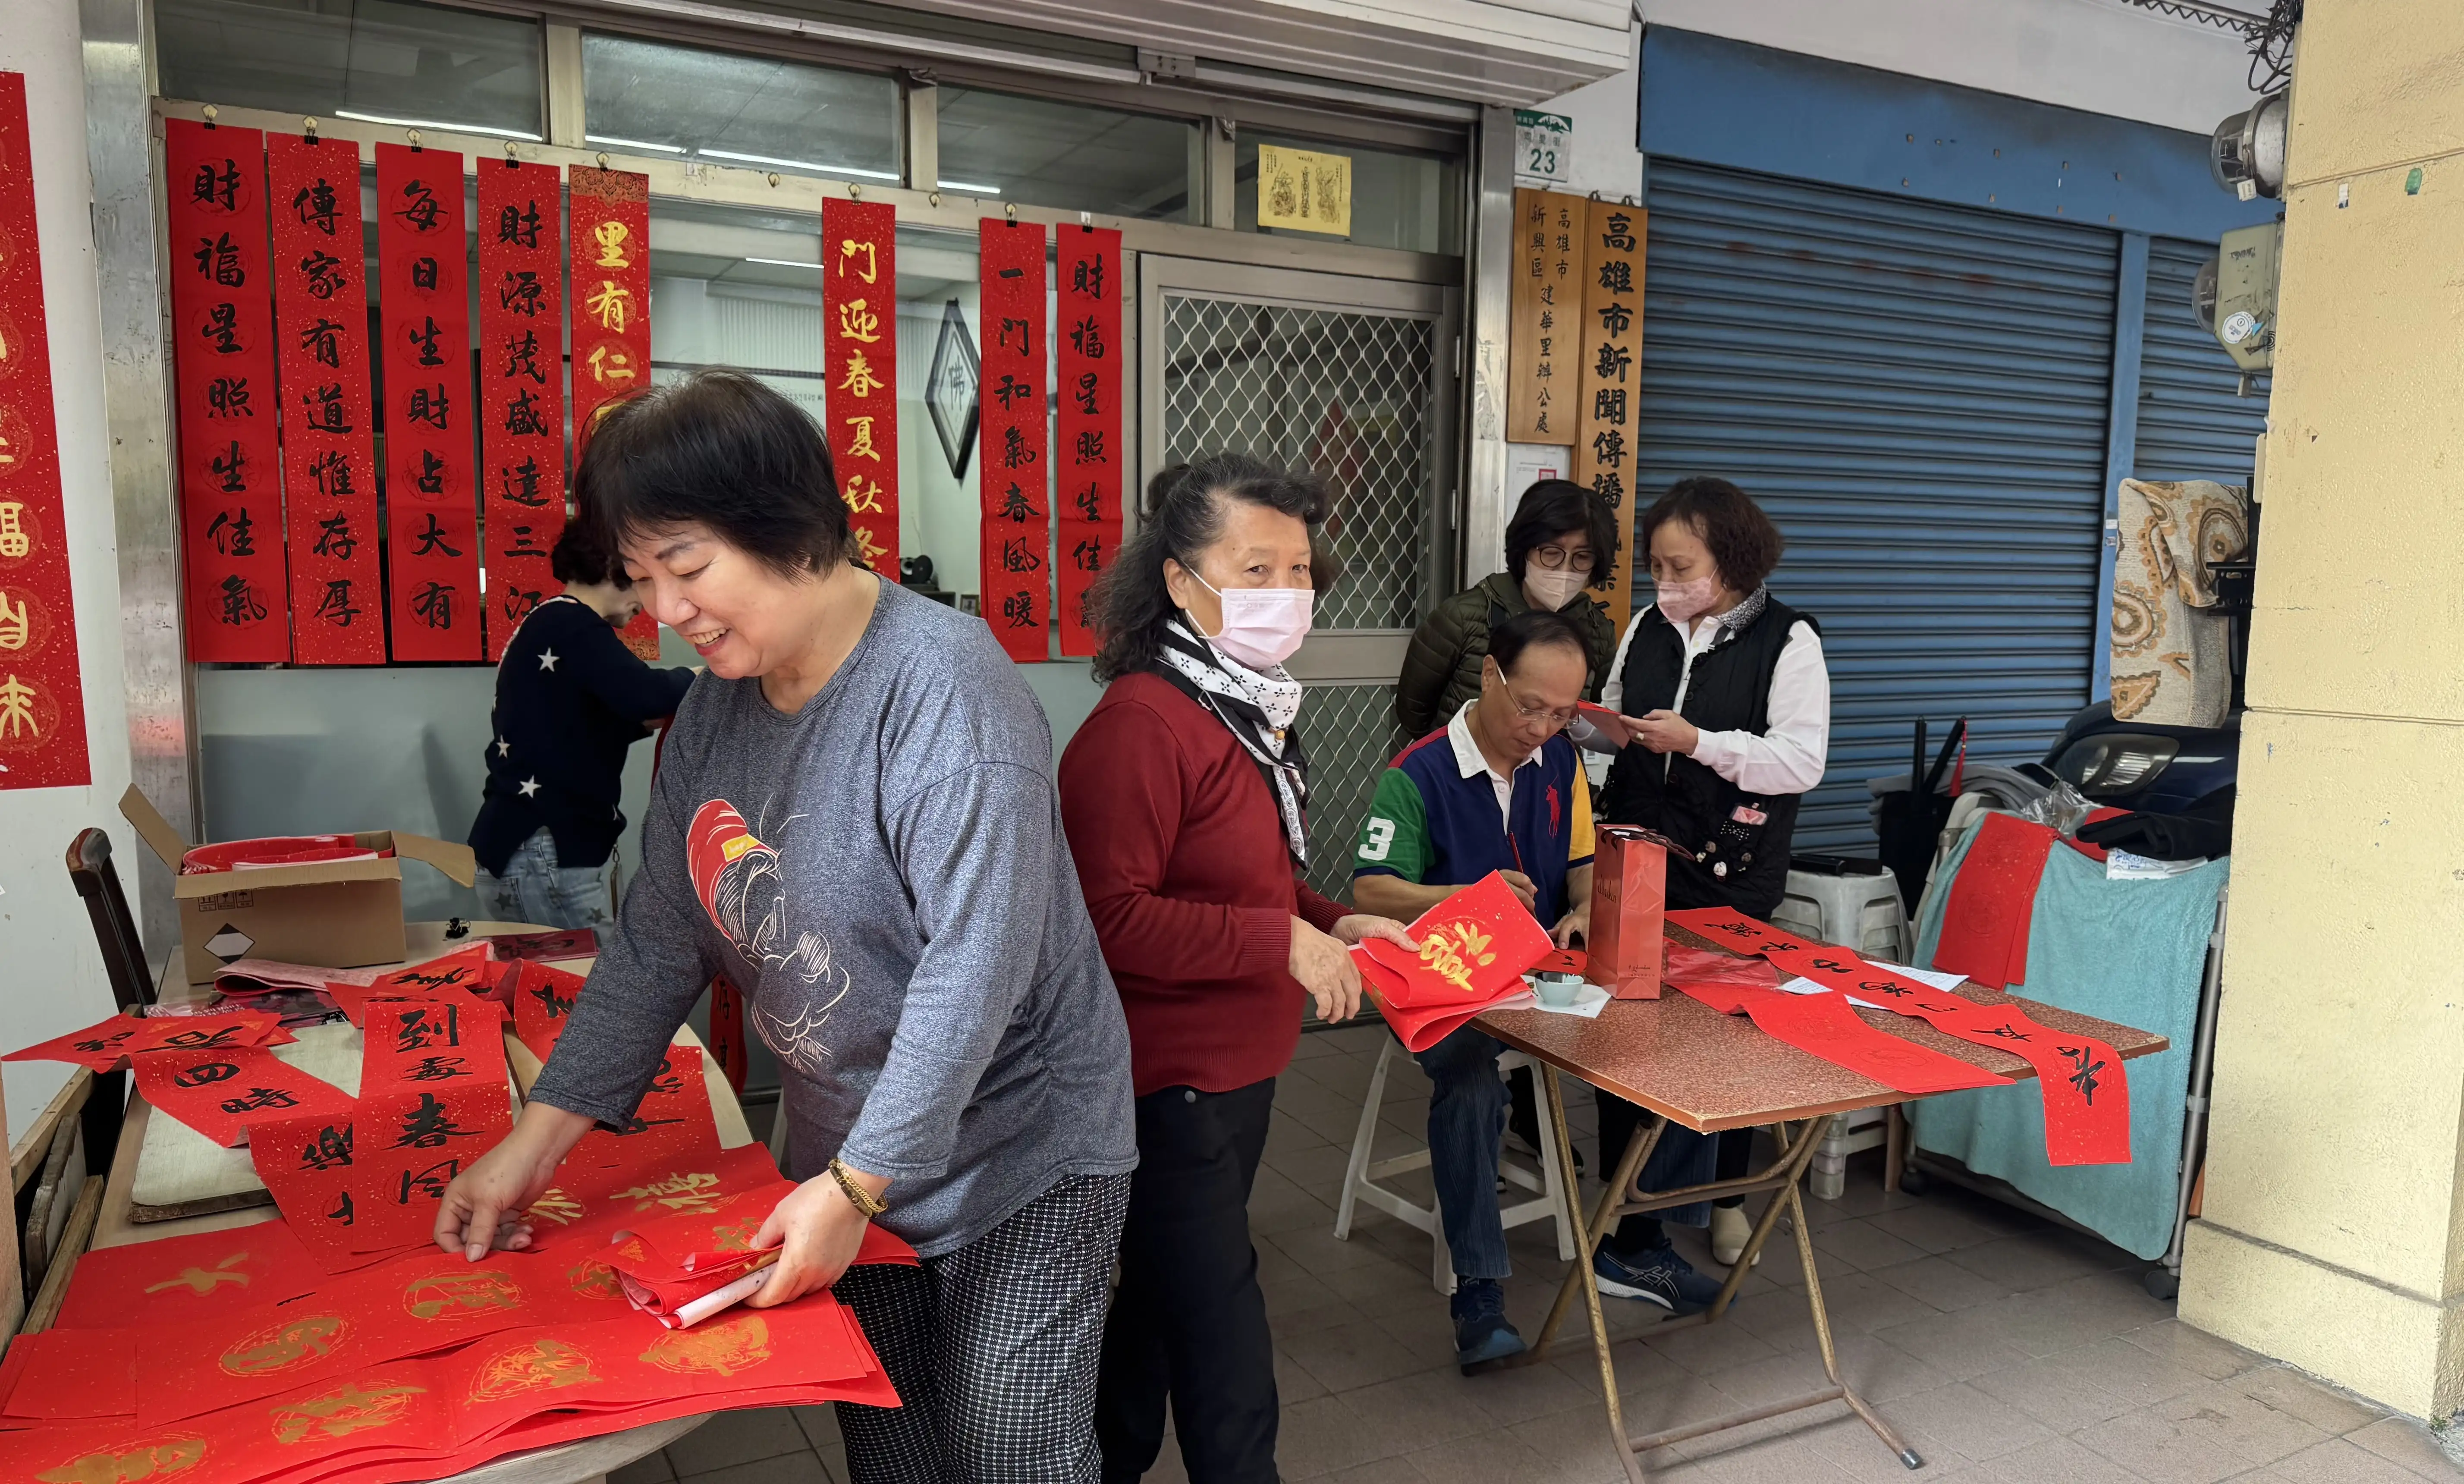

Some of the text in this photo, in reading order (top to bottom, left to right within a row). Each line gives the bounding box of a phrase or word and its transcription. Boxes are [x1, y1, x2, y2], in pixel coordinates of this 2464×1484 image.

[1529, 148, 1555, 173] 23
[1531, 204, 1546, 277] 新興區
[1556, 208, 1571, 280] 高雄市
[190, 159, 267, 626] 財福星照生佳氣
[391, 179, 462, 630] 每日生財占大有
[587, 221, 635, 414] 里有仁
[995, 268, 1040, 629] 一門和氣春風暖
[1070, 253, 1107, 628] 財福星照生佳
[1592, 212, 1637, 610] 高雄市新聞傳播
[1358, 817, 1395, 861] 3
